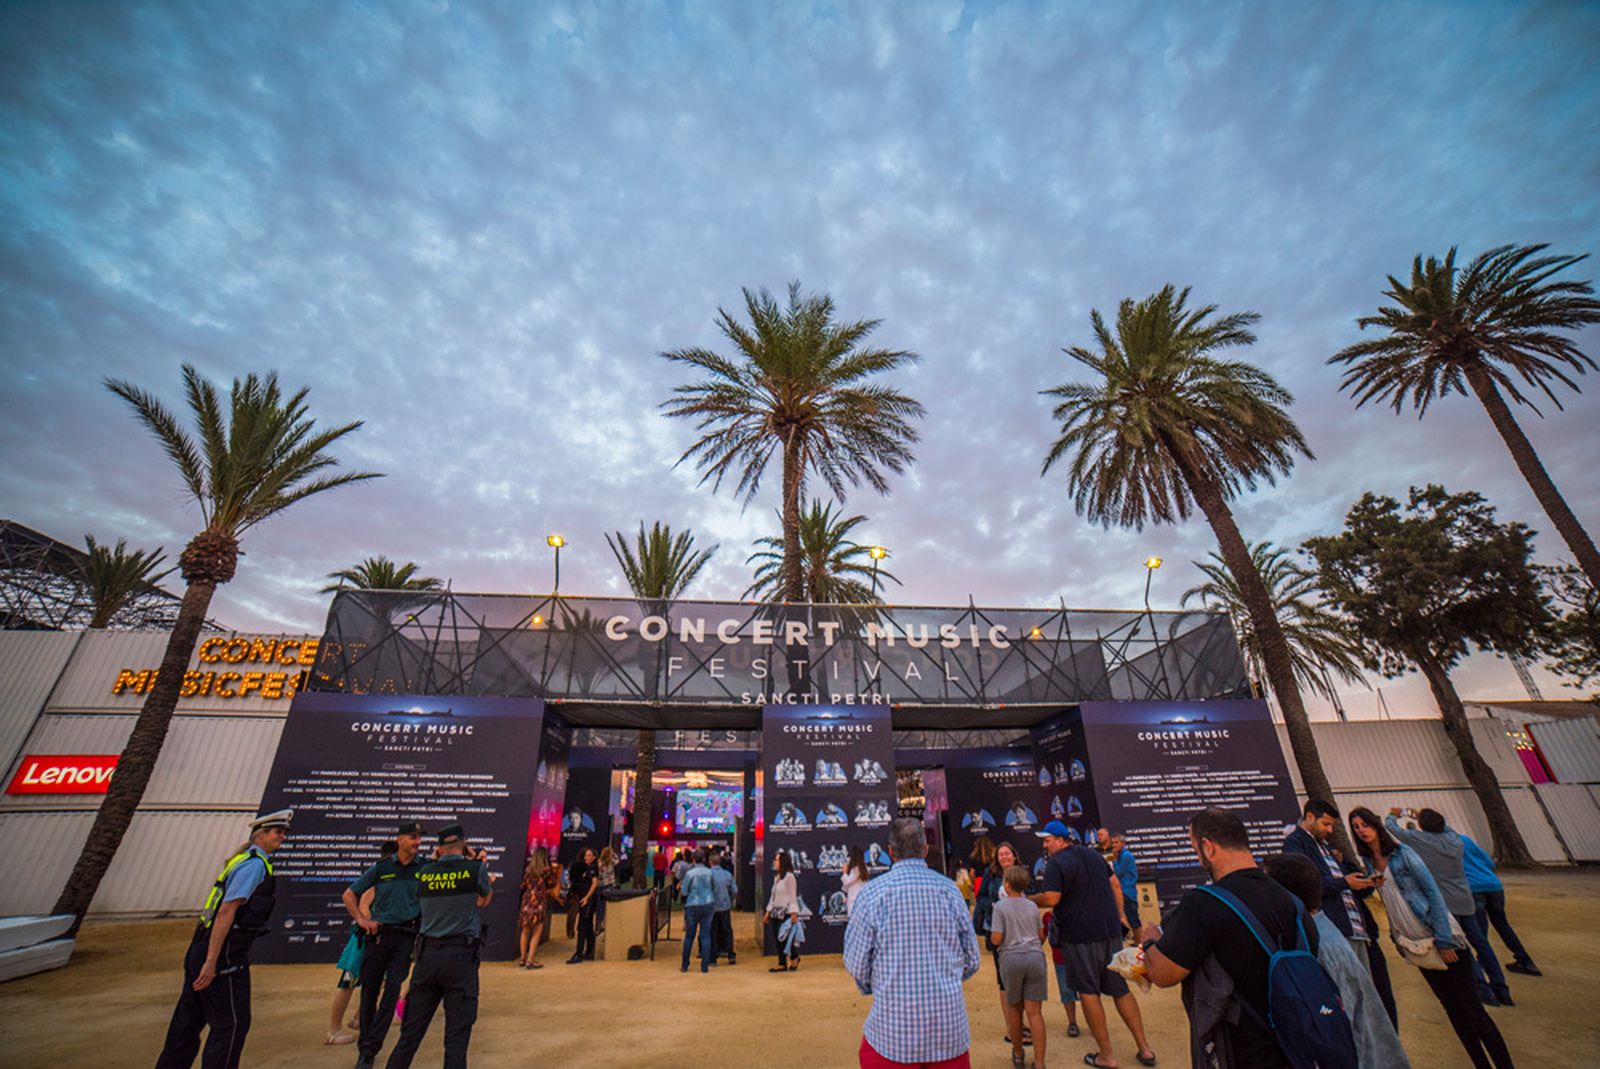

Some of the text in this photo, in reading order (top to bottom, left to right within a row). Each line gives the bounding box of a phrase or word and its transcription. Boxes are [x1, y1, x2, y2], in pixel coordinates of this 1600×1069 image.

[605, 615, 1010, 649] CONCERT MUSIC
[667, 656, 960, 681] FESTIVAL
[741, 692, 891, 705] SANCTI PETRI
[351, 722, 475, 736] CONCERT MUSIC
[783, 724, 873, 733] CONCERT MUSIC
[1137, 729, 1230, 741] CONCERT MUSIC
[366, 734, 454, 745] FESTIVAL
[1153, 741, 1220, 749] FESTIVAL
[22, 762, 117, 785] Lenov
[421, 869, 470, 882] GUARDIA
[427, 880, 457, 891] CIVIL
